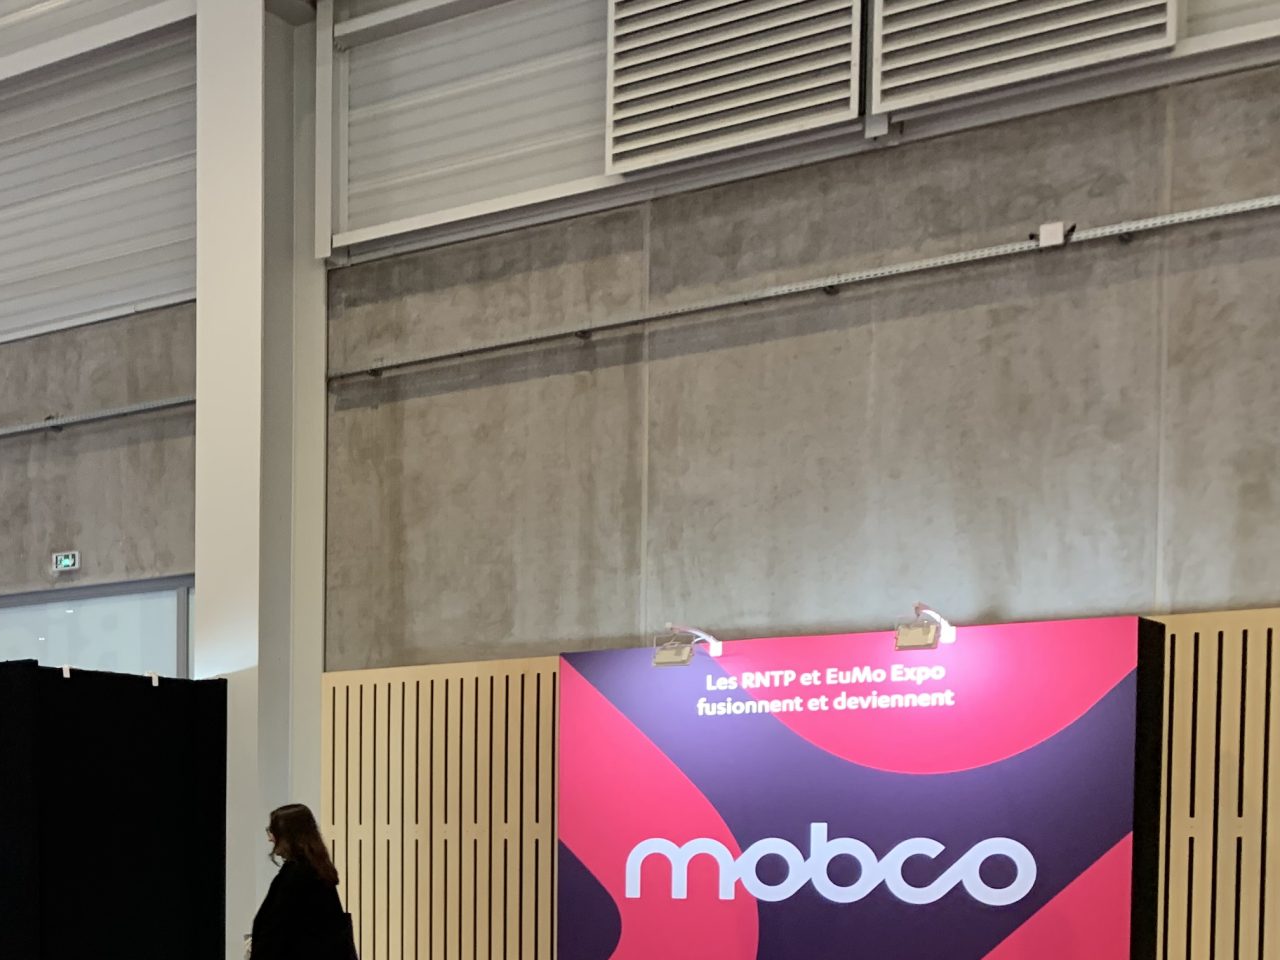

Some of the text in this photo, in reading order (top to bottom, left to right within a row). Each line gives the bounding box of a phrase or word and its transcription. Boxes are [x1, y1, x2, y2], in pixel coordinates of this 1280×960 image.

[706, 664, 946, 691] Les RNTP et EuMo Expo
[696, 689, 955, 716] fusionnent et deviennent
[625, 822, 1037, 906] mobco
